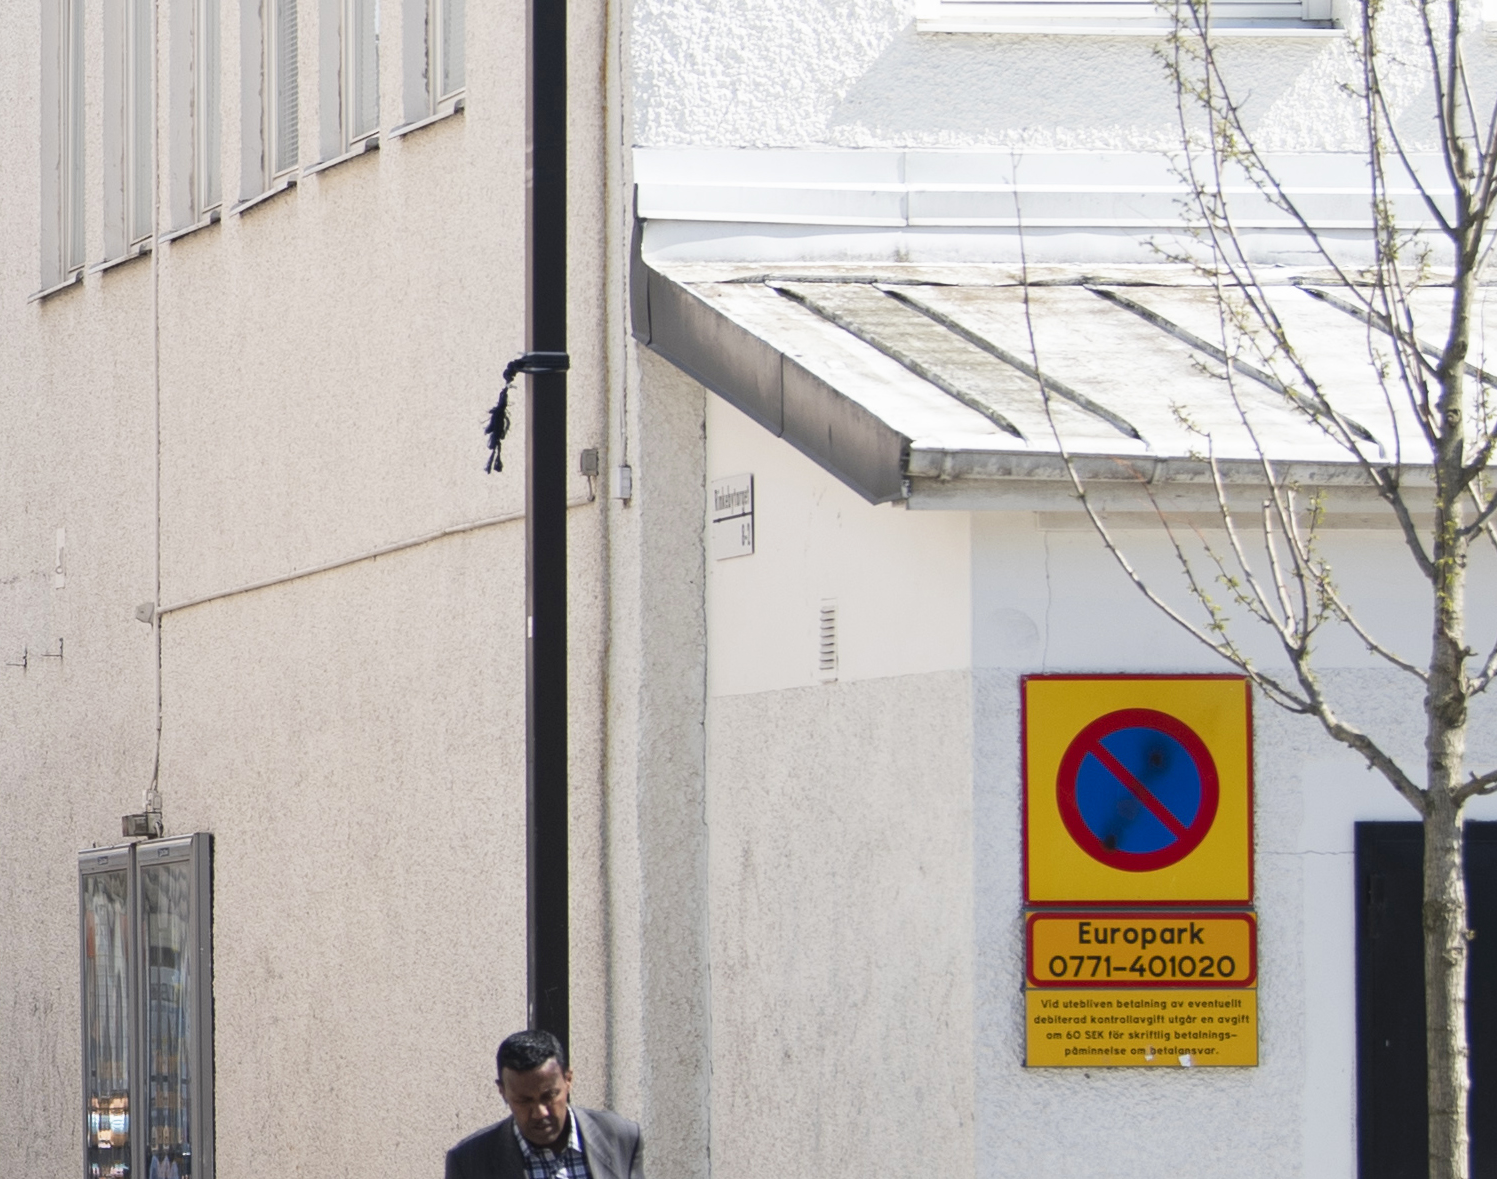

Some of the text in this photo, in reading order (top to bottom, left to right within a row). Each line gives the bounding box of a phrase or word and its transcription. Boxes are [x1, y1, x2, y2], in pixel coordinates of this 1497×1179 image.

[1078, 921, 1205, 949] Europark
[1048, 955, 1236, 978] 0771-401020
[1041, 1000, 1059, 1009] Vid
[1062, 1000, 1113, 1009] utebliven
[1116, 1000, 1167, 1011] betalning
[1171, 1001, 1184, 1009] av
[1033, 1015, 1087, 1024] debiterad
[1168, 1015, 1197, 1026] utgår
[1217, 1015, 1250, 1026] avgift
[1046, 1032, 1062, 1040] om
[1066, 1030, 1081, 1040] 60
[1085, 1030, 1104, 1040] SEK
[1108, 1030, 1124, 1040] för
[1128, 1030, 1171, 1042] skriftlig
[1130, 1047, 1147, 1055] om
